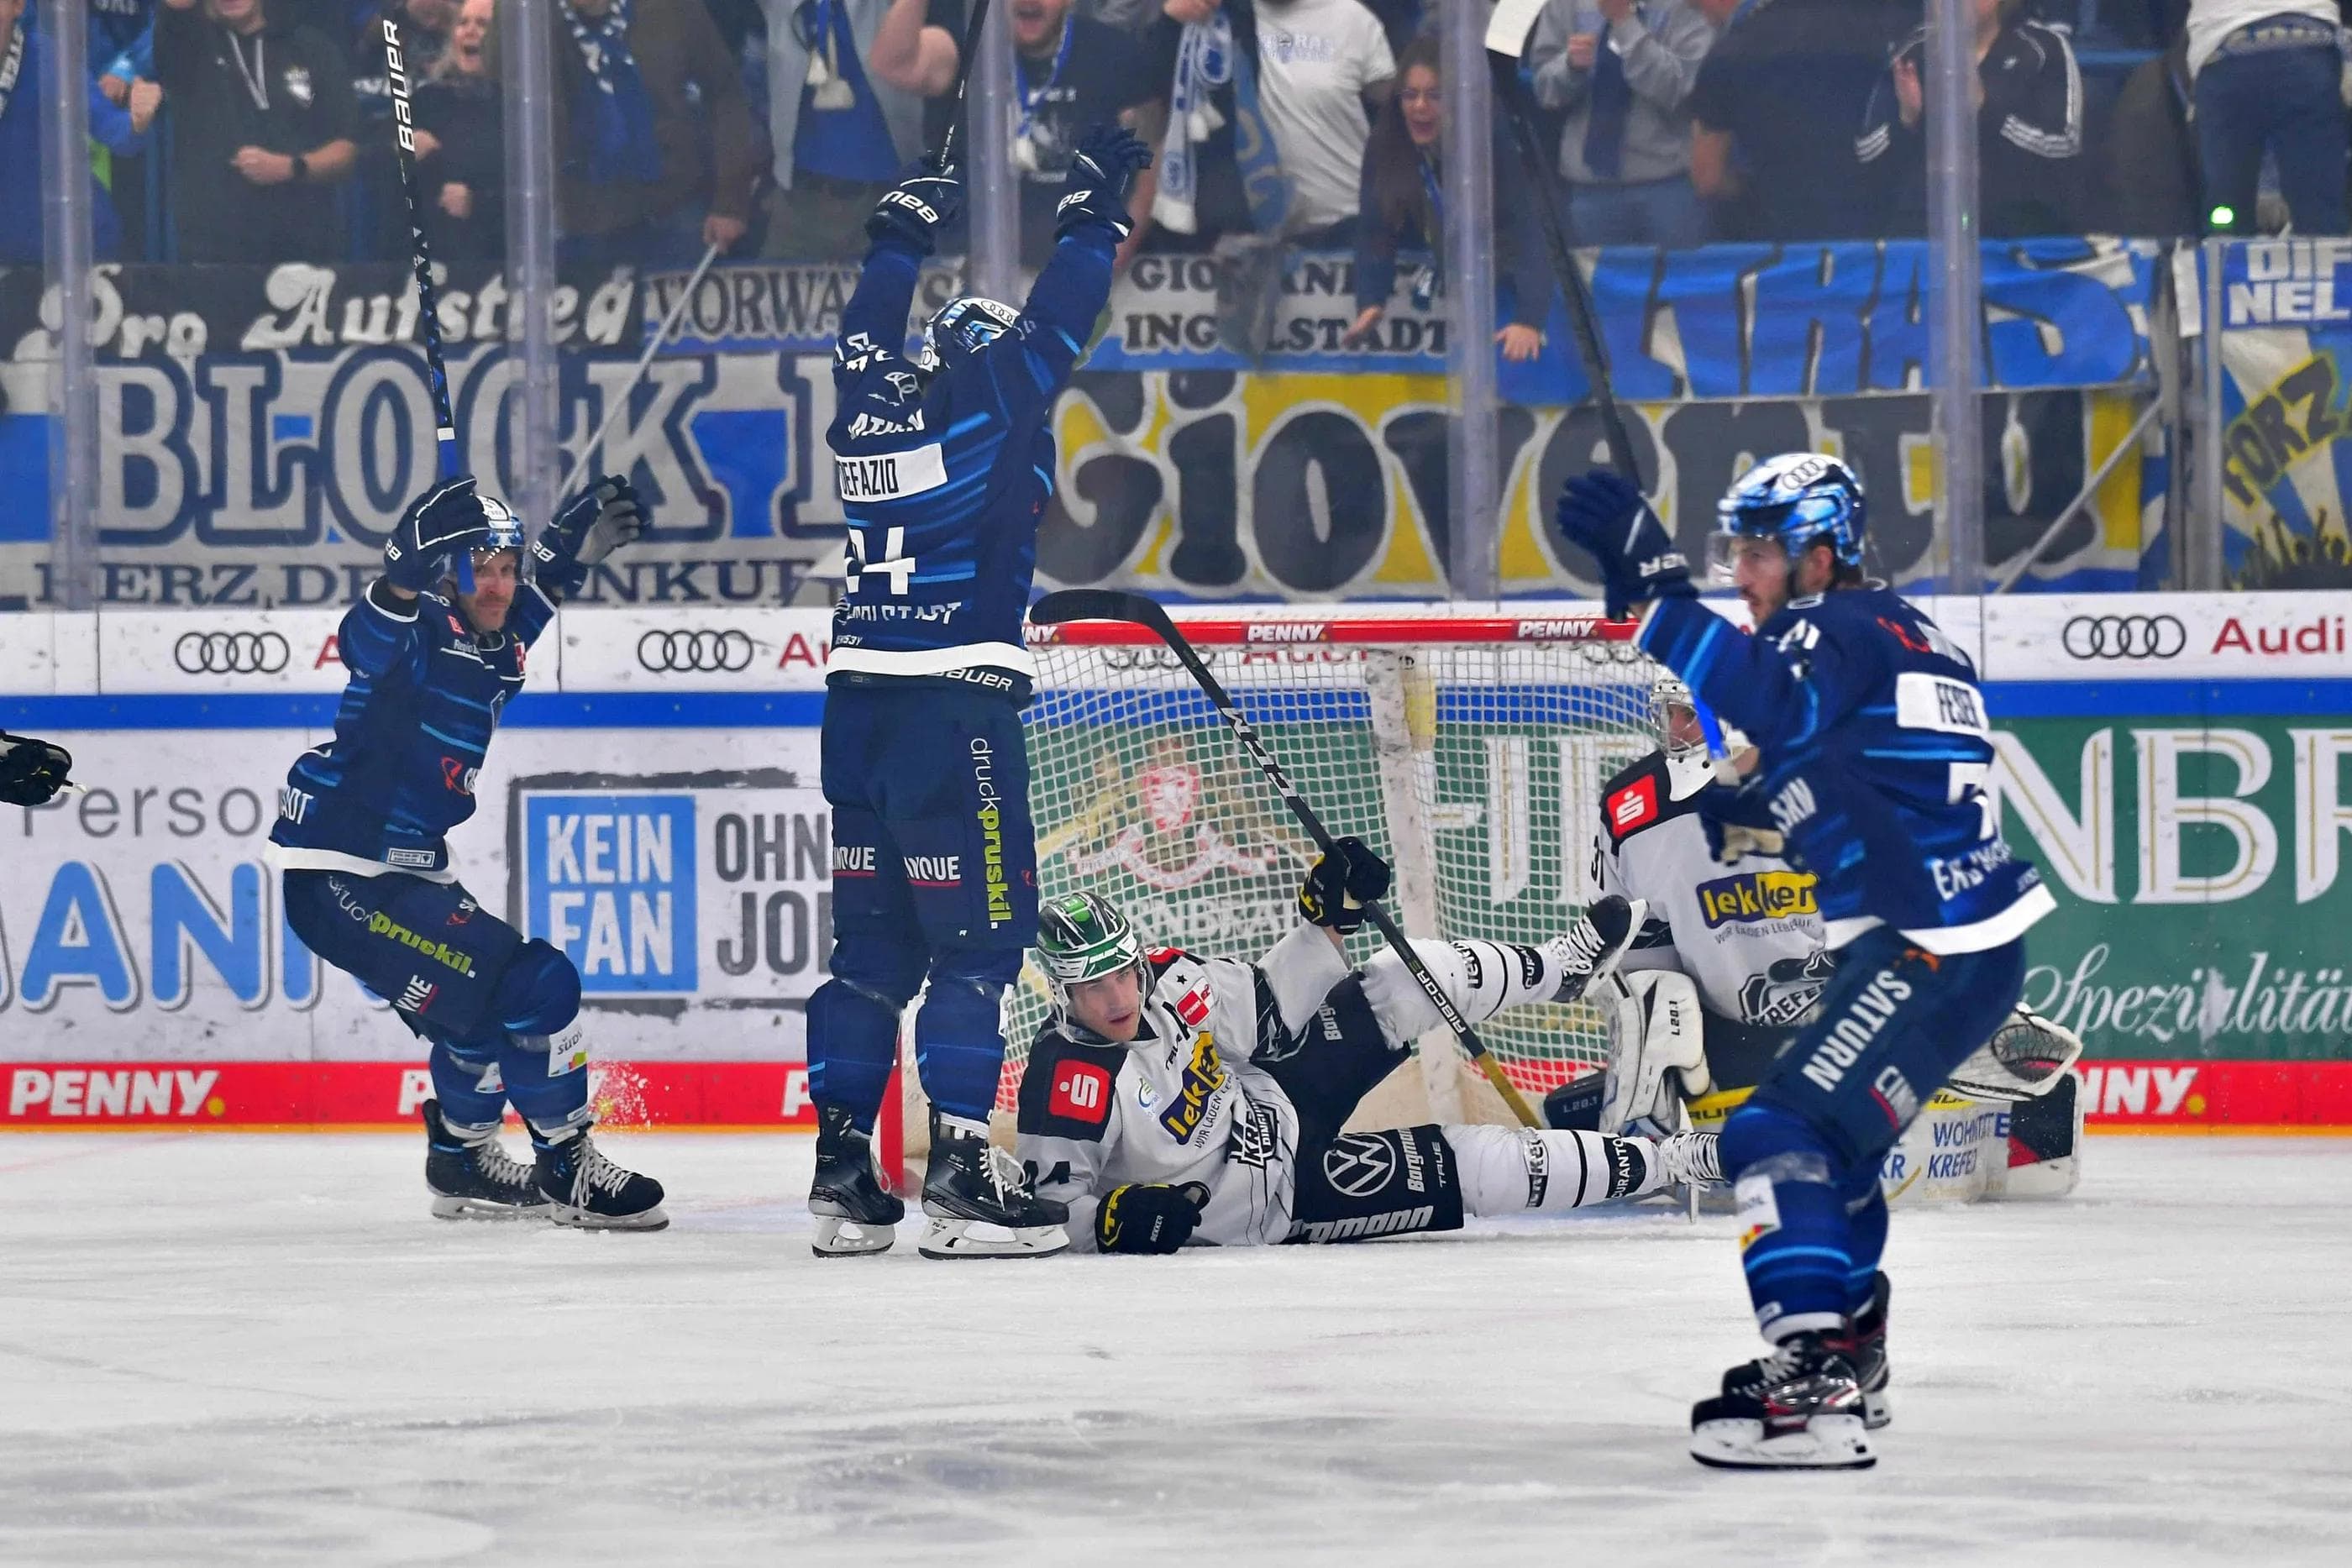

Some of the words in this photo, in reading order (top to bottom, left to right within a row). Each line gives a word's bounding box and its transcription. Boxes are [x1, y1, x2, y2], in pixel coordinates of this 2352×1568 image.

[382, 18, 416, 153] BAUER
[875, 190, 940, 224] BAU
[1583, 242, 2147, 396] LTRAS
[2228, 281, 2350, 325] NEL
[1125, 312, 1448, 356] INGLSTADT
[96, 353, 727, 544] BLOCK
[280, 563, 388, 606] DE
[2211, 617, 2345, 655] Audi
[927, 666, 1014, 692] AUER
[24, 784, 286, 838] Perso
[547, 815, 671, 884] KEIN
[1703, 878, 1814, 923] lekker
[549, 891, 671, 976] FAN
[1317, 1002, 1344, 1042] Borg
[1416, 968, 1467, 1035] RIBCOR
[1800, 968, 1913, 1092] SATURN
[1194, 1125, 1211, 1149] WIR
[1205, 1094, 1223, 1130] LADEN
[1288, 1204, 1435, 1245] rgmann
